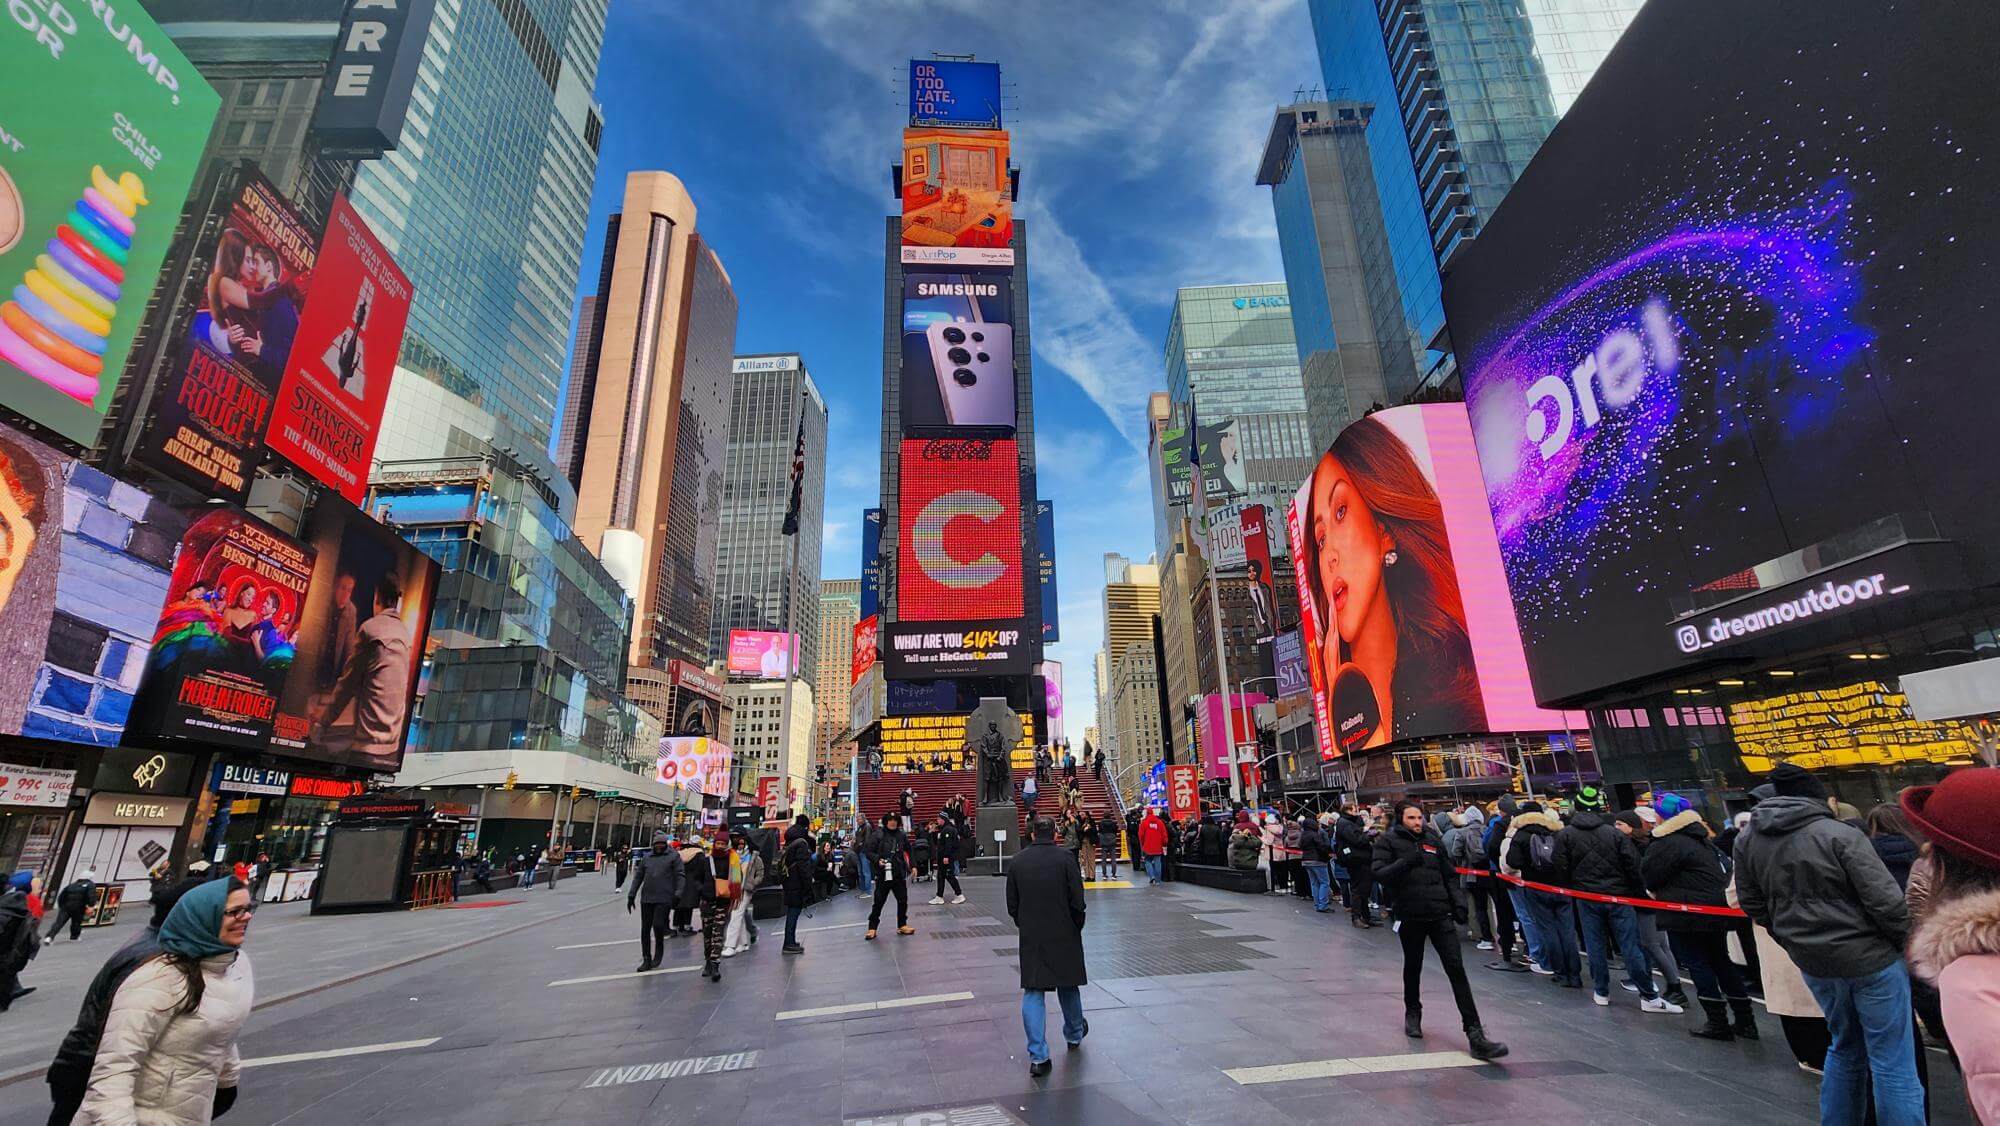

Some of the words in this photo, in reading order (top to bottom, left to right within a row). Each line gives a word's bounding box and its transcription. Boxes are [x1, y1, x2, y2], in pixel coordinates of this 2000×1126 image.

[916, 65, 935, 77] OR
[916, 77, 944, 90] TOO
[916, 90, 955, 104] LATE,
[916, 102, 948, 115] TO...
[112, 126, 155, 170] CARE
[114, 112, 162, 161] CHILD
[242, 187, 314, 270] SPECTACULAR
[339, 211, 381, 266] BROADWAY
[347, 235, 361, 255] ON
[359, 252, 379, 277] SALE
[378, 272, 399, 299] NOW
[919, 249, 957, 260] ArtPop
[918, 283, 998, 297] SAMSUNG
[188, 348, 259, 413] MOULIN
[738, 360, 774, 370] Allianz
[293, 385, 365, 457] STRANGER
[299, 414, 352, 466] THINGS
[163, 438, 219, 479] AVAILABLE
[218, 467, 244, 492] NOW!
[177, 425, 212, 454] GREAT
[211, 446, 241, 473] SEATS
[284, 425, 301, 448] THE
[302, 436, 325, 464] FIRST
[325, 453, 359, 487] SHADOW
[227, 529, 240, 540] 10
[240, 533, 271, 555] TONY
[271, 549, 312, 576] AWARDS
[243, 524, 305, 563] WINNER!
[221, 543, 256, 569] BEST
[256, 560, 309, 593] MUSICAL!
[894, 634, 922, 650] WHAT
[923, 633, 943, 650] ARE
[943, 632, 962, 648] YOU
[962, 630, 999, 649] SICK
[999, 630, 1019, 646] OF?
[904, 654, 919, 663] Tell
[940, 651, 1008, 662] HeGetsUs.com
[178, 677, 232, 711] MOULIN
[230, 691, 277, 720] ROUGE!
[224, 765, 261, 783] BLUE
[266, 770, 289, 785] FIN
[1173, 768, 1194, 808] tkts
[114, 803, 165, 818] HEYTEA
[584, 1052, 745, 1088] BEAUMONT
